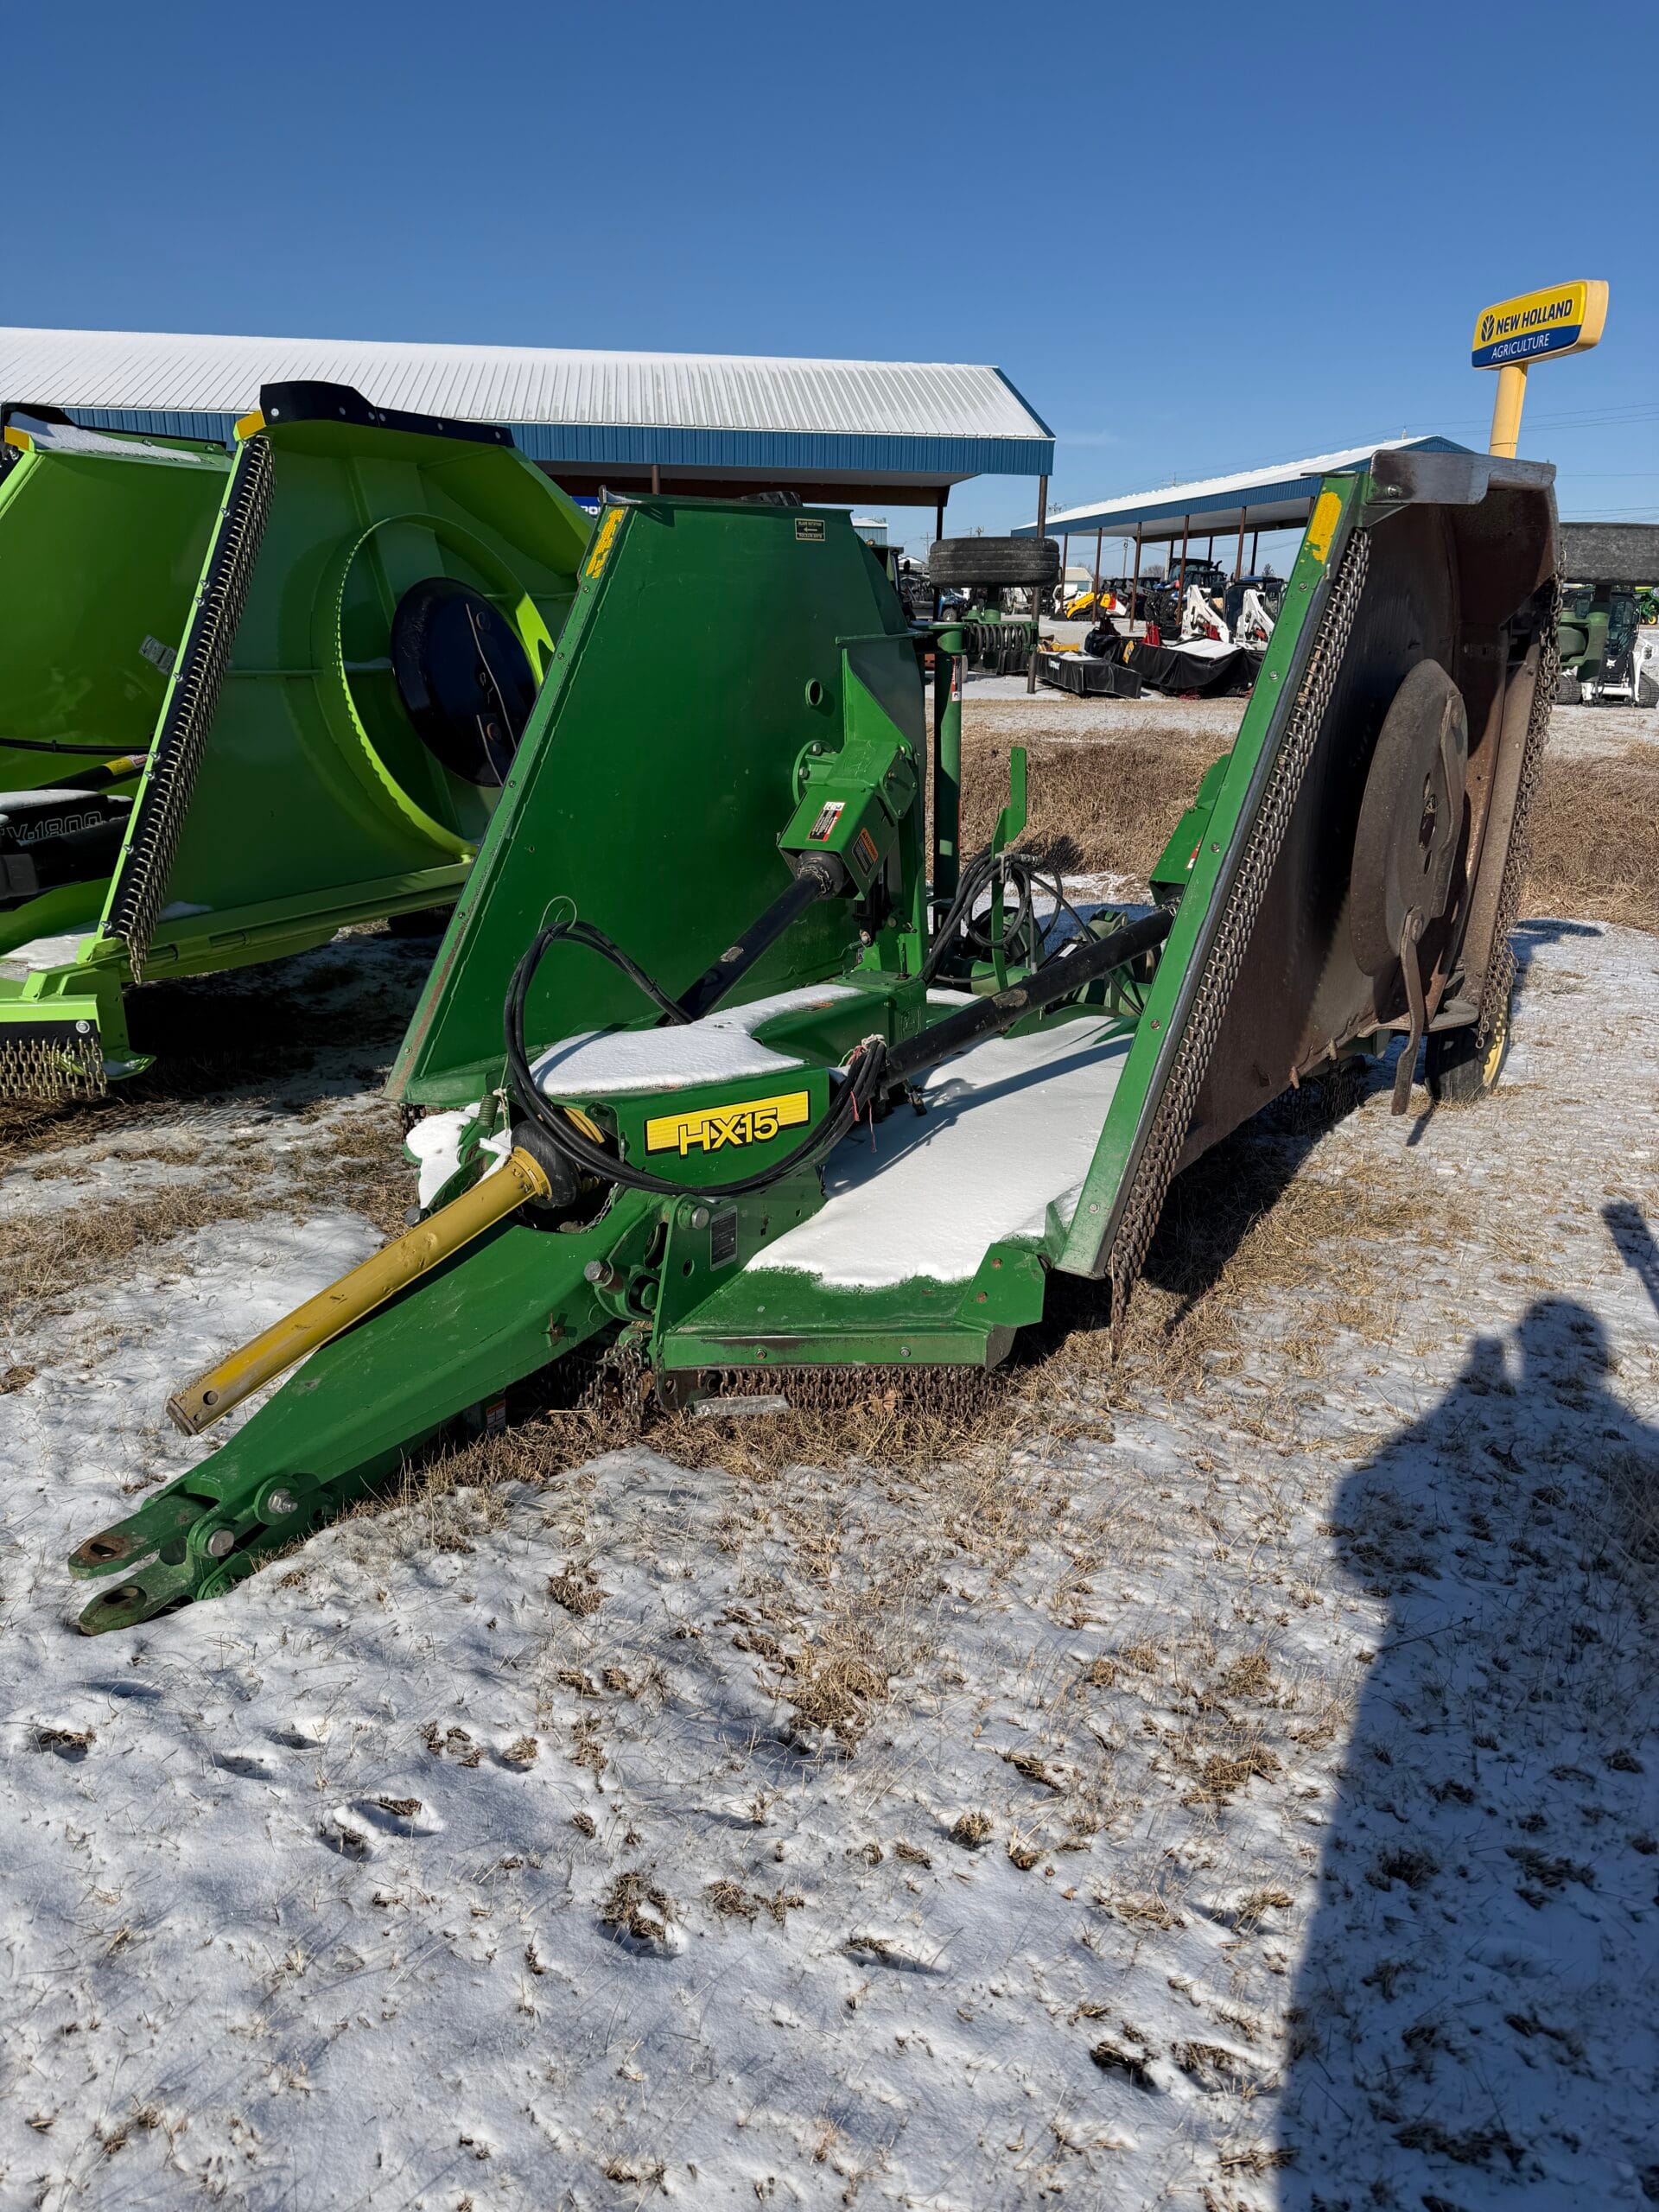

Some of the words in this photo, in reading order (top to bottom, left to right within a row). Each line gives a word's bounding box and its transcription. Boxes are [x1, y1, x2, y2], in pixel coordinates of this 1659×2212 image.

[1496, 314, 1521, 335] NEW
[1521, 299, 1573, 328] HOLLAND
[1491, 333, 1550, 359] AGRICULTURE
